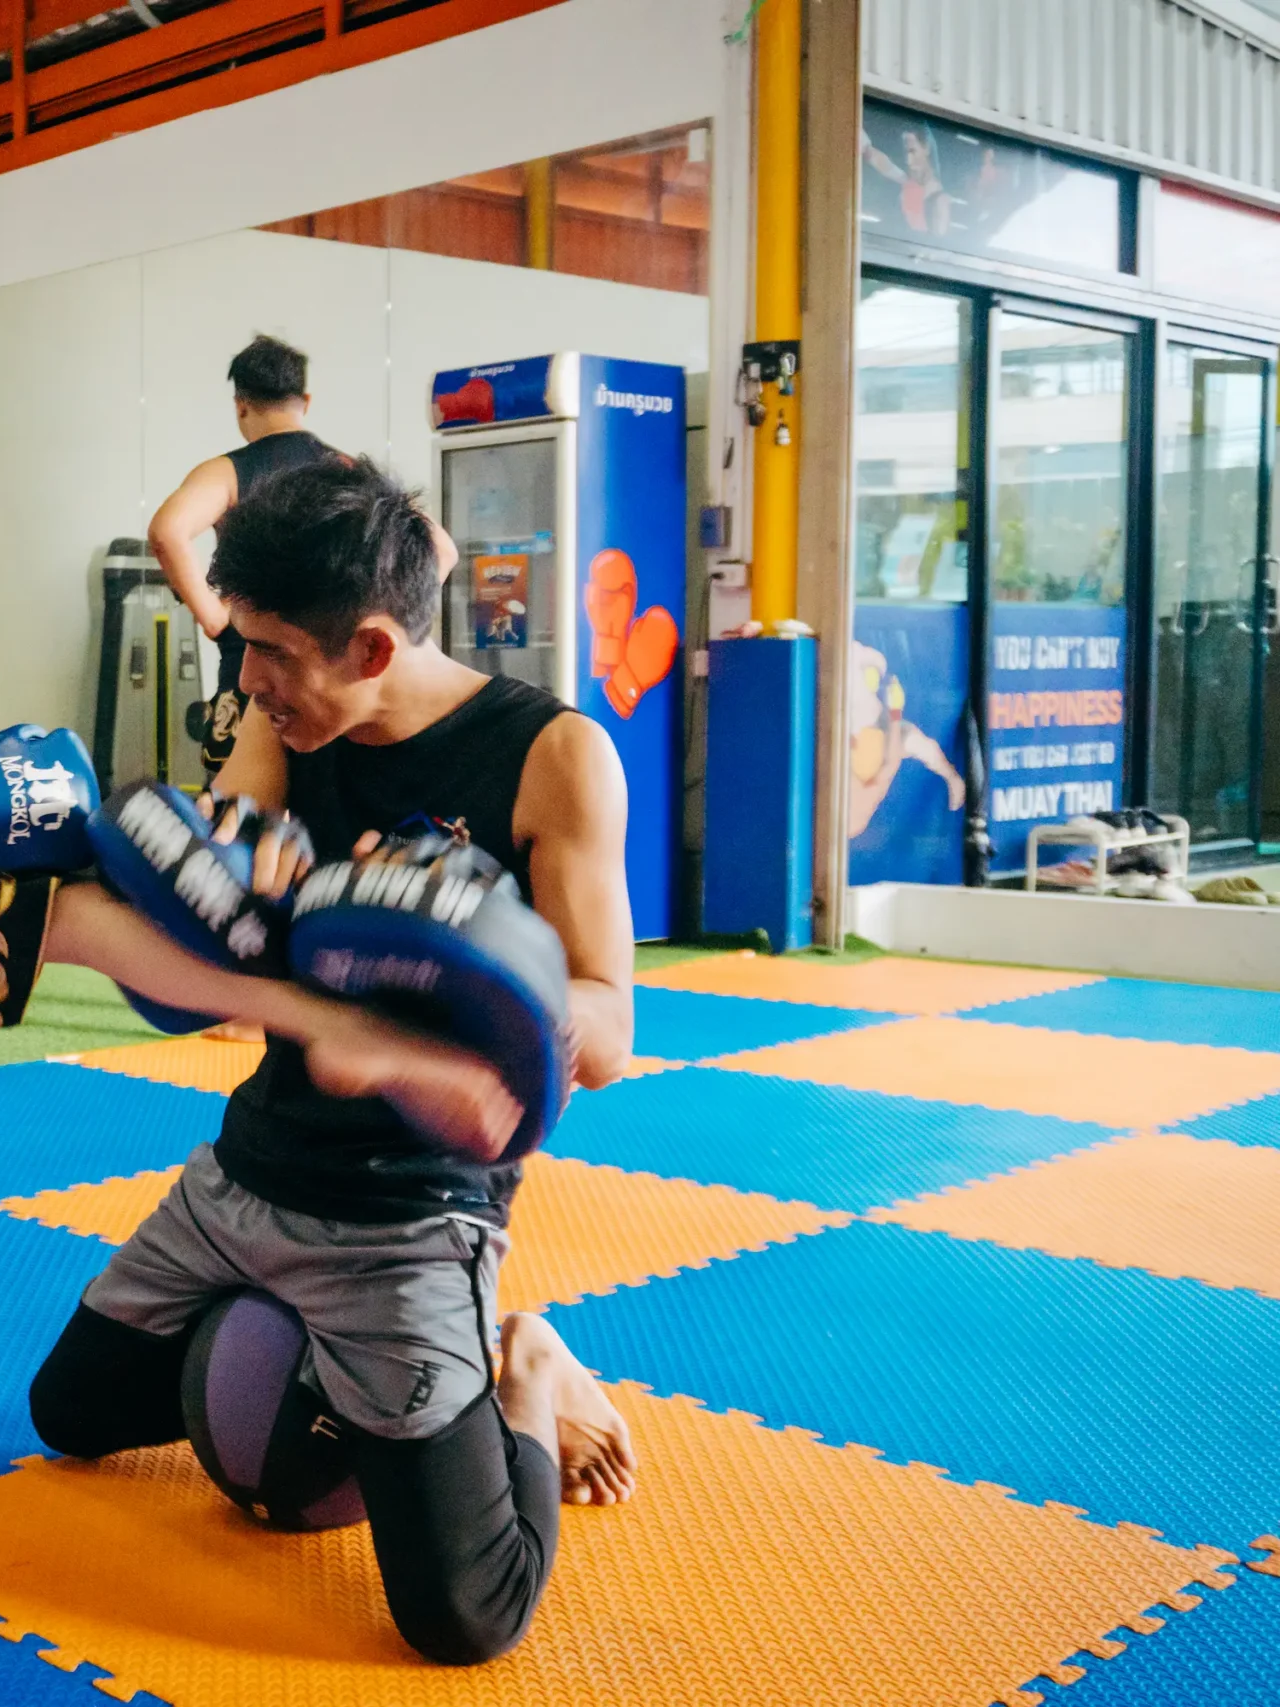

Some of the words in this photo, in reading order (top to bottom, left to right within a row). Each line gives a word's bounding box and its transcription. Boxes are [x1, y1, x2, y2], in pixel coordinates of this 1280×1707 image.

[594, 383, 673, 416] บ้านครูมวย
[995, 635, 1031, 669] YOU
[989, 690, 1122, 729] HAPPINESS
[992, 783, 1060, 822] MUAY
[1062, 780, 1113, 815] THAI
